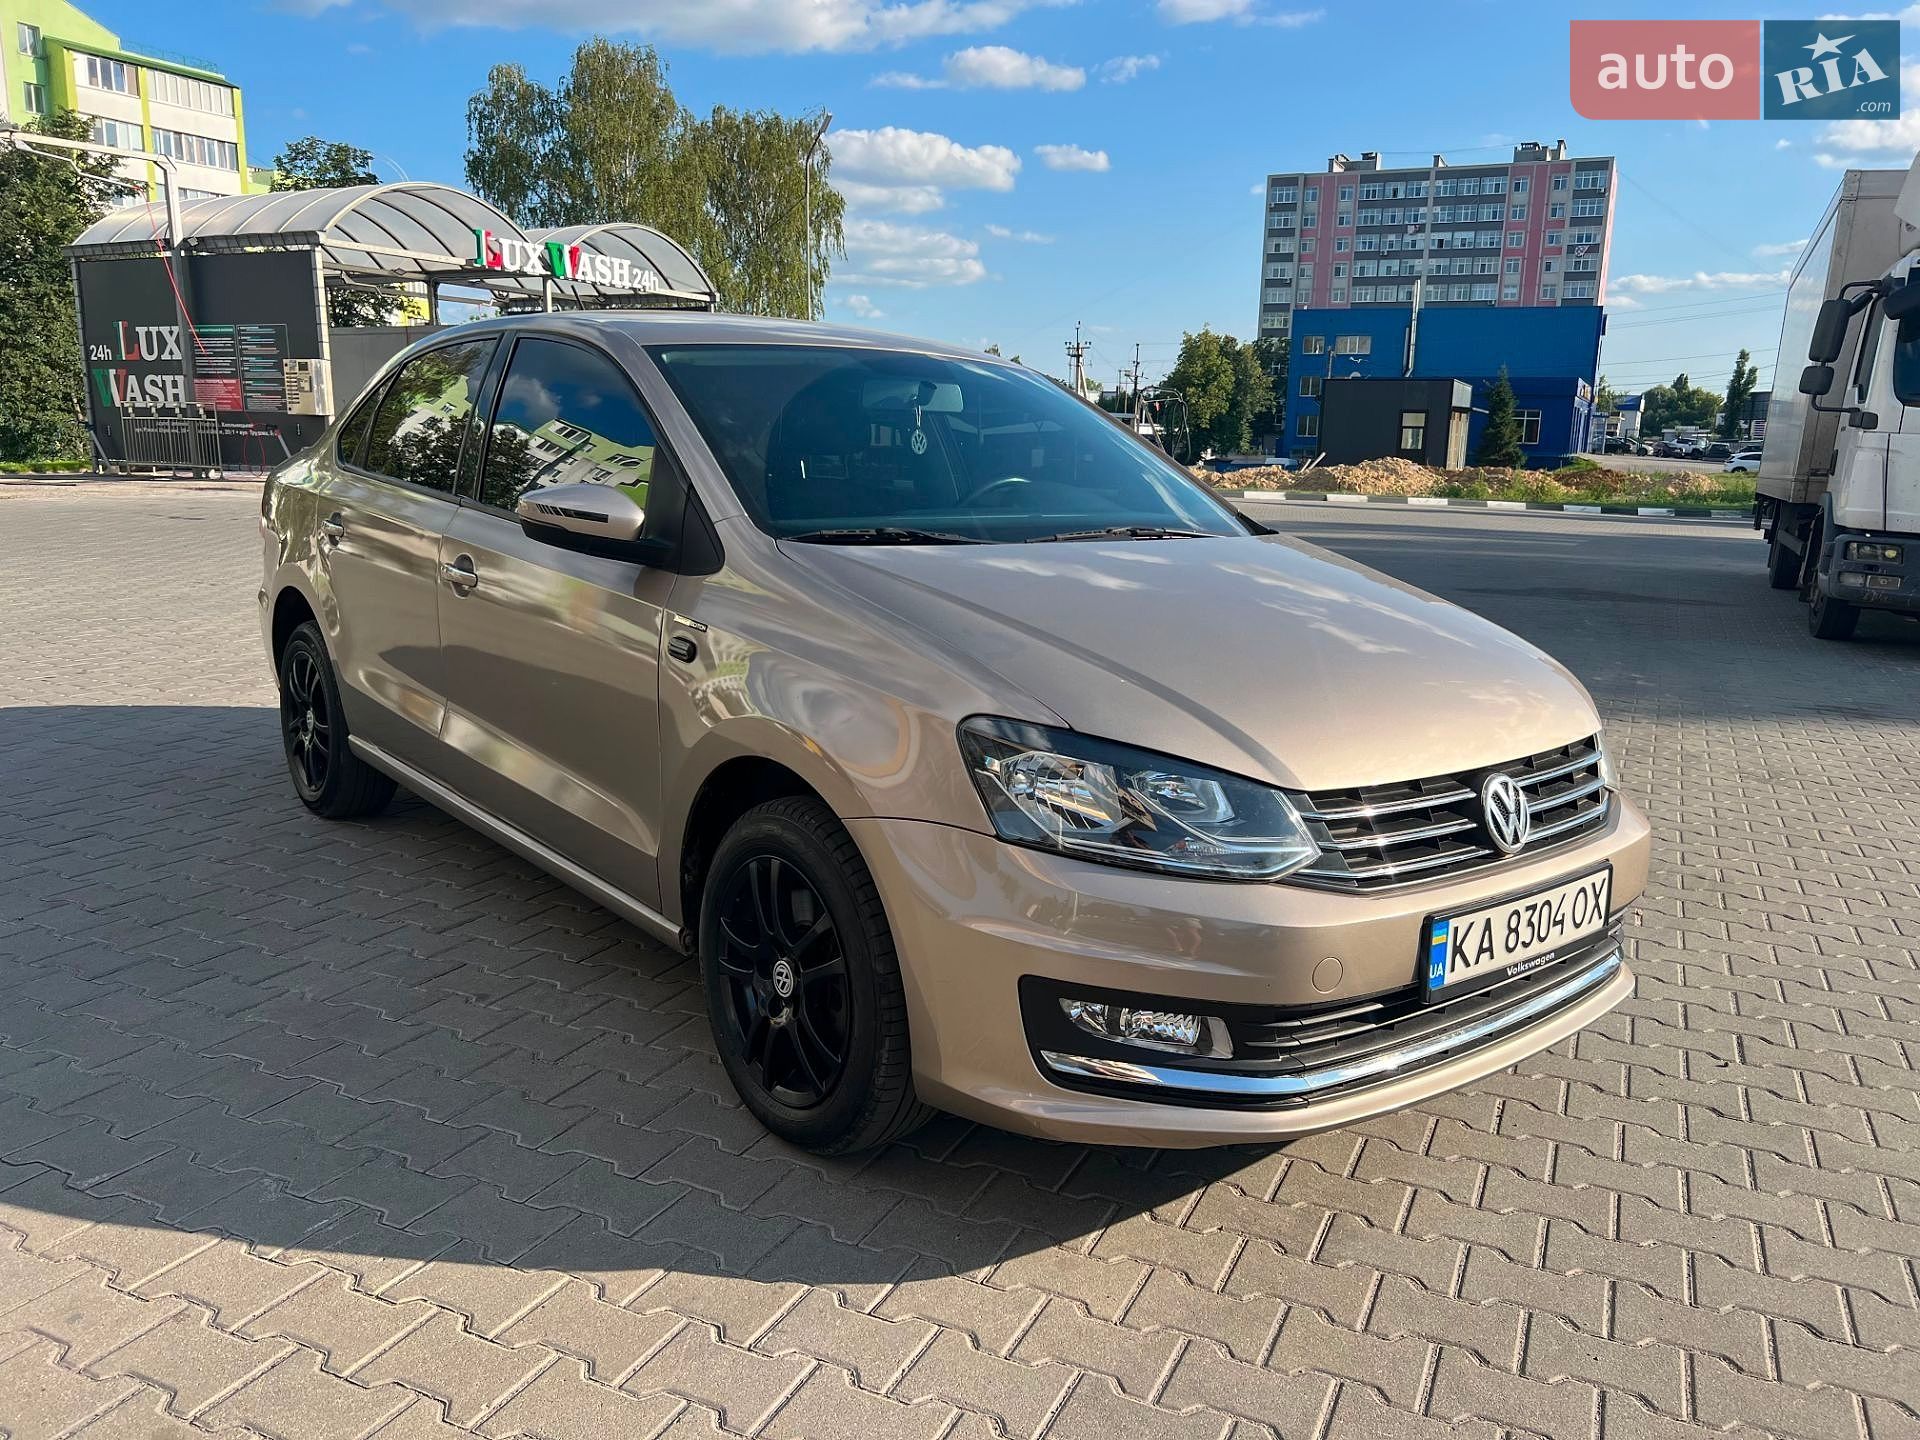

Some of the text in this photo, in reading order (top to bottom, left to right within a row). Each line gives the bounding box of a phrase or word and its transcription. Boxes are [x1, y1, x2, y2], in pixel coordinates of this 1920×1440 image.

[473, 228, 660, 293] LUX WASH 24h
[89, 344, 113, 361] 24h
[112, 320, 183, 361] LUX
[92, 368, 188, 408] WASH
[1450, 877, 1607, 973] KA 8304 OX
[1429, 961, 1444, 980] UA
[1506, 951, 1555, 977] Volkswagen
